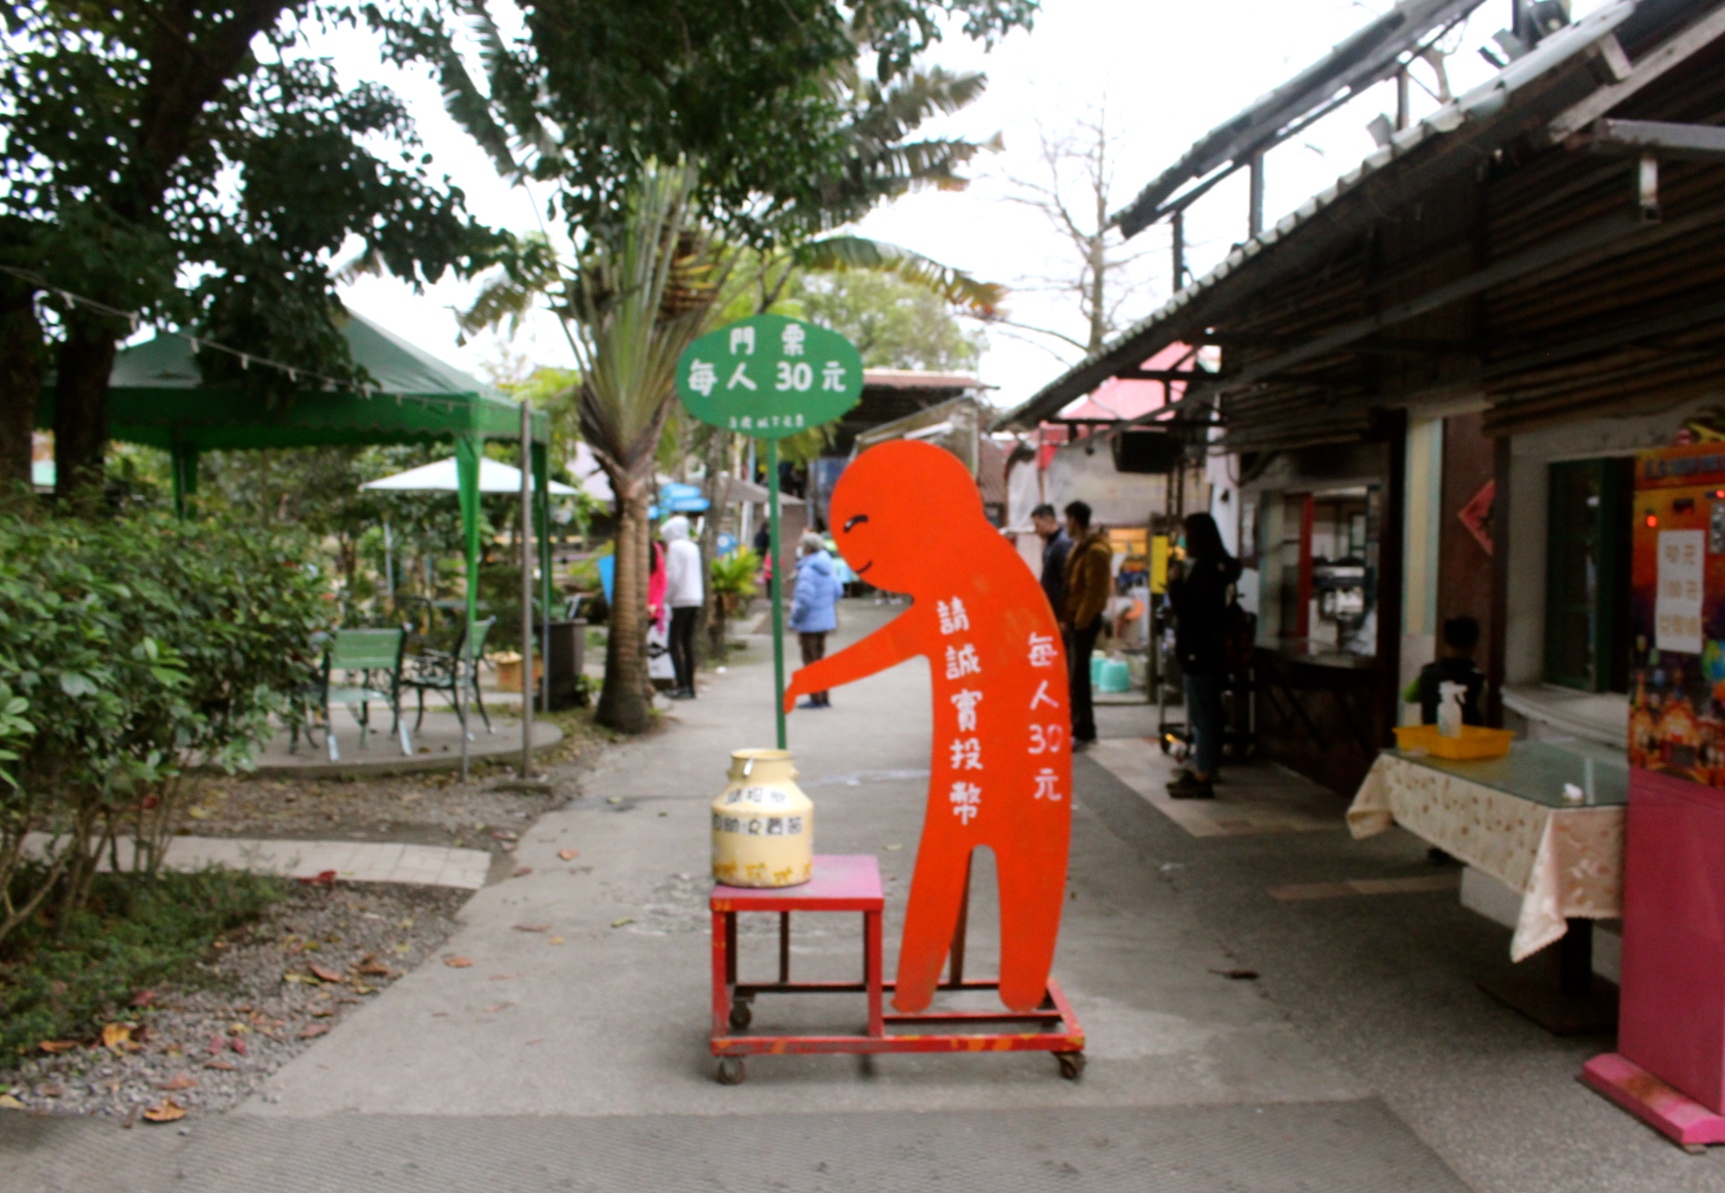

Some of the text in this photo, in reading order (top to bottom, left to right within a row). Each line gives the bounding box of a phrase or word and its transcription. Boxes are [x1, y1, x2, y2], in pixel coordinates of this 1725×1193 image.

[687, 358, 847, 397] 每人30元
[729, 323, 806, 356] 門票
[937, 596, 983, 826] 請誠實投幣
[1028, 632, 1063, 801] 每人30元
